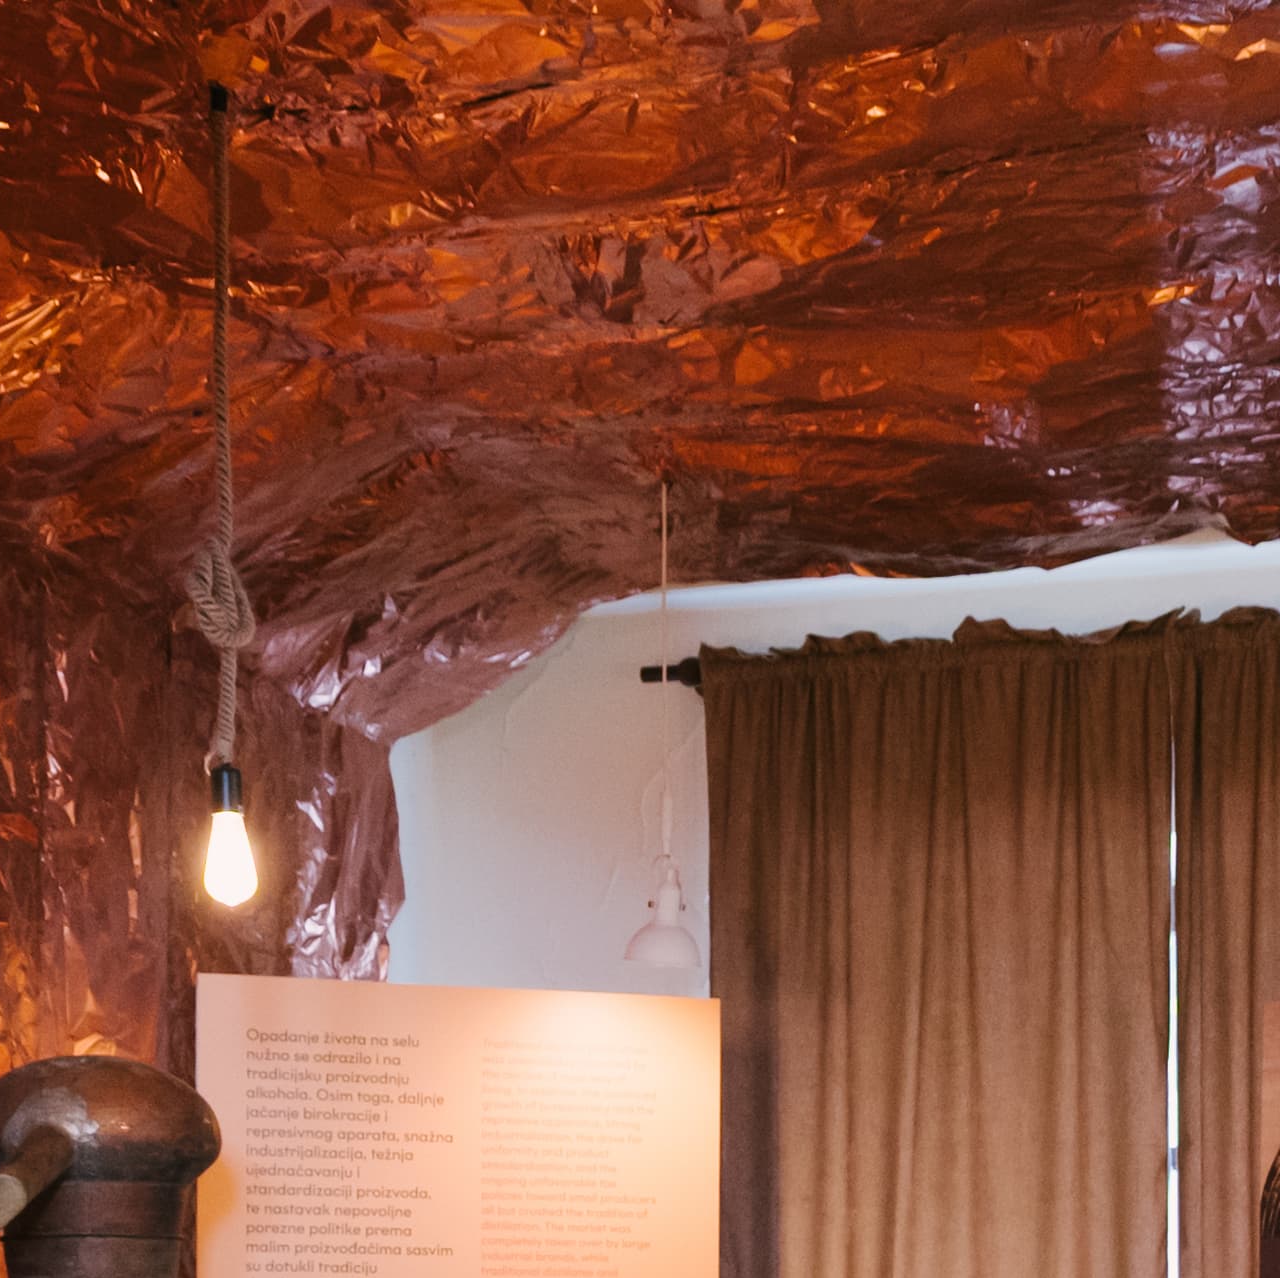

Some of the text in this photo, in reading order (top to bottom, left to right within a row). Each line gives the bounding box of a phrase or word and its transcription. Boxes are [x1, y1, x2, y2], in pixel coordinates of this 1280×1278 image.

[245, 1028, 420, 1047] Opadanje života na selu
[245, 1049, 402, 1066] nužno se odrazilo i na
[245, 1068, 410, 1085] tradicijsku proizvodnju
